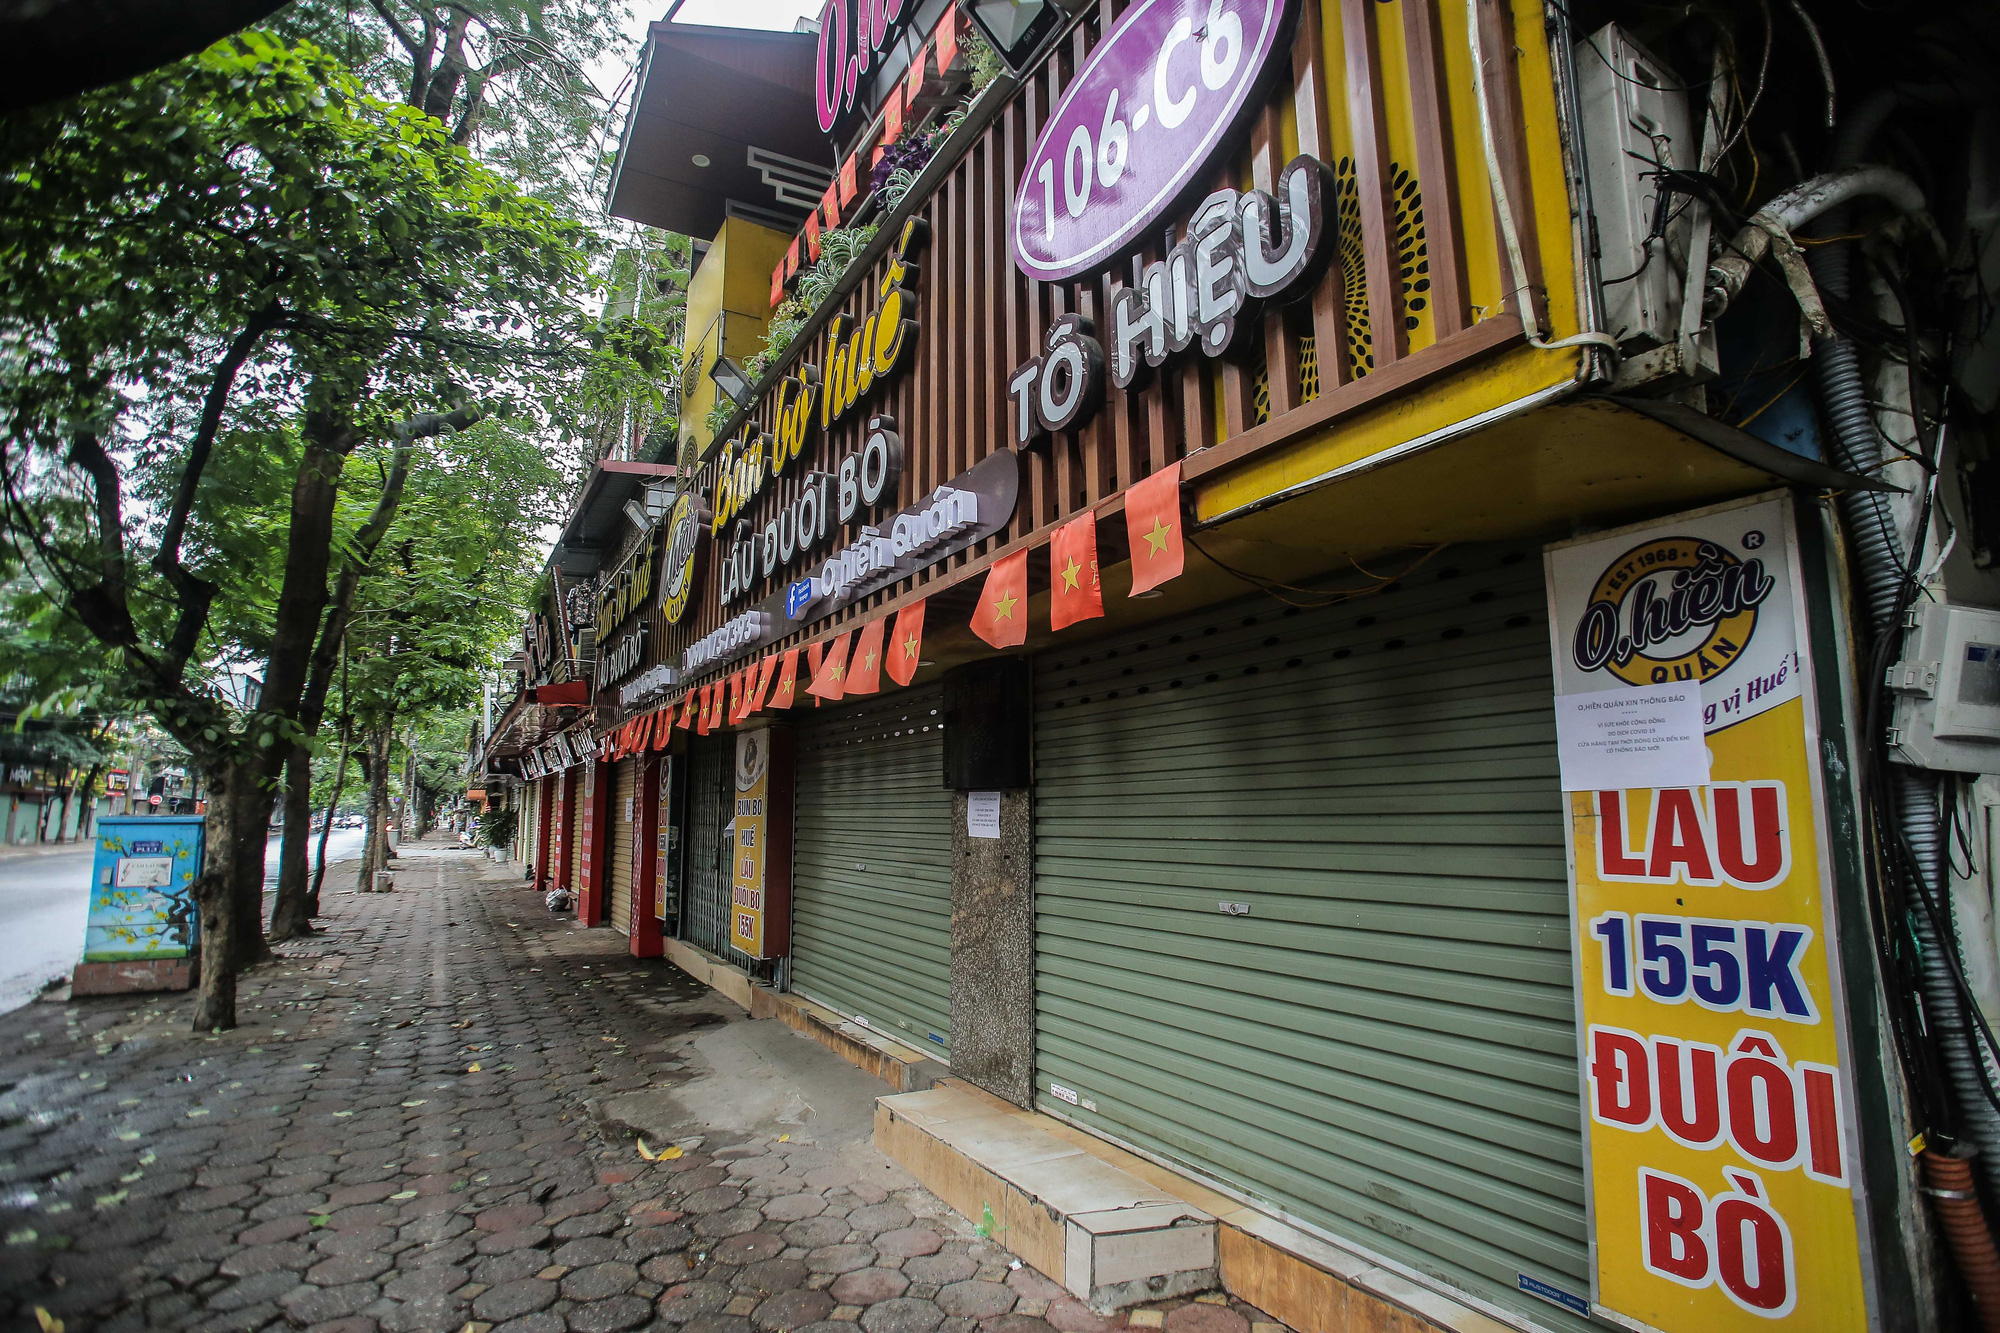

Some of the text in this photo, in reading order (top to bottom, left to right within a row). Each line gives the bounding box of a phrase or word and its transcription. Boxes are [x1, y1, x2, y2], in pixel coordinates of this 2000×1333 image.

[1038, 0, 1243, 242] 106-C6
[822, 220, 914, 431] huế
[1010, 166, 1309, 443] TÔ HIỆU
[721, 519, 756, 606] LẨU
[763, 474, 828, 578] ĐUÔI
[839, 418, 888, 523] BÒ
[891, 485, 978, 557] Quán
[1608, 547, 1679, 591] EST 1968
[1625, 699, 1638, 707] XIN
[1640, 696, 1667, 705] THÔNG
[1668, 694, 1686, 703] BÁO
[1650, 636, 1740, 684] QUÁN
[1721, 687, 1740, 715] vị
[1630, 718, 1647, 727] CỘNG
[737, 913, 755, 941] 155K
[1596, 917, 1811, 1017] 155K
[1591, 1030, 1843, 1180] ĐUÔI
[1645, 1172, 1788, 1310] BÒ
